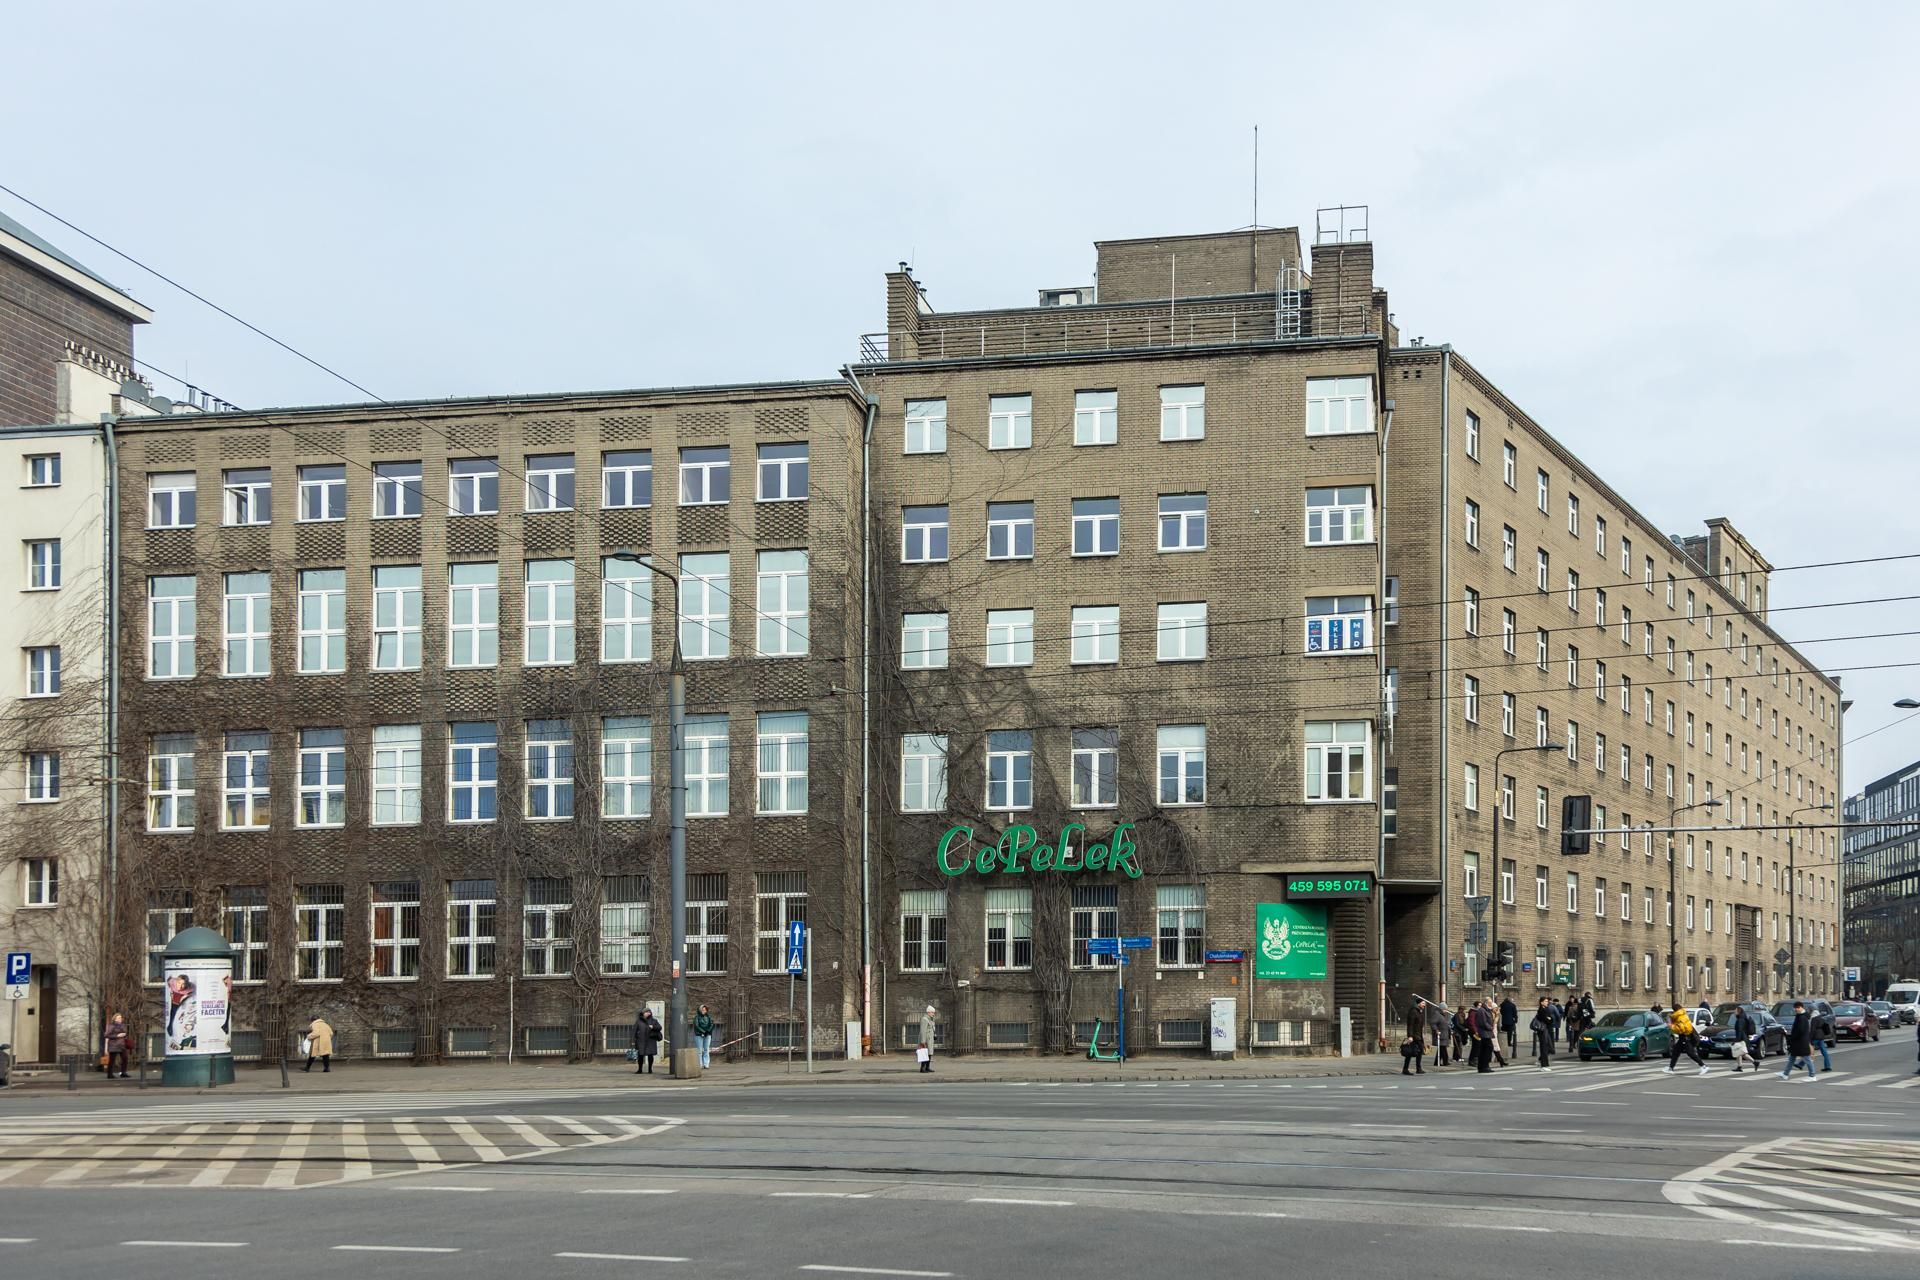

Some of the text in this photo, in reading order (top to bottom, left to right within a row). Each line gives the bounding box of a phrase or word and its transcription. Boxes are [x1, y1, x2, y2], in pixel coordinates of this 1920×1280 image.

[1353, 622, 1361, 647] MED
[937, 823, 1142, 878] CePeLek
[1288, 880, 1369, 892] 459 595 071
[12, 955, 27, 976] P
